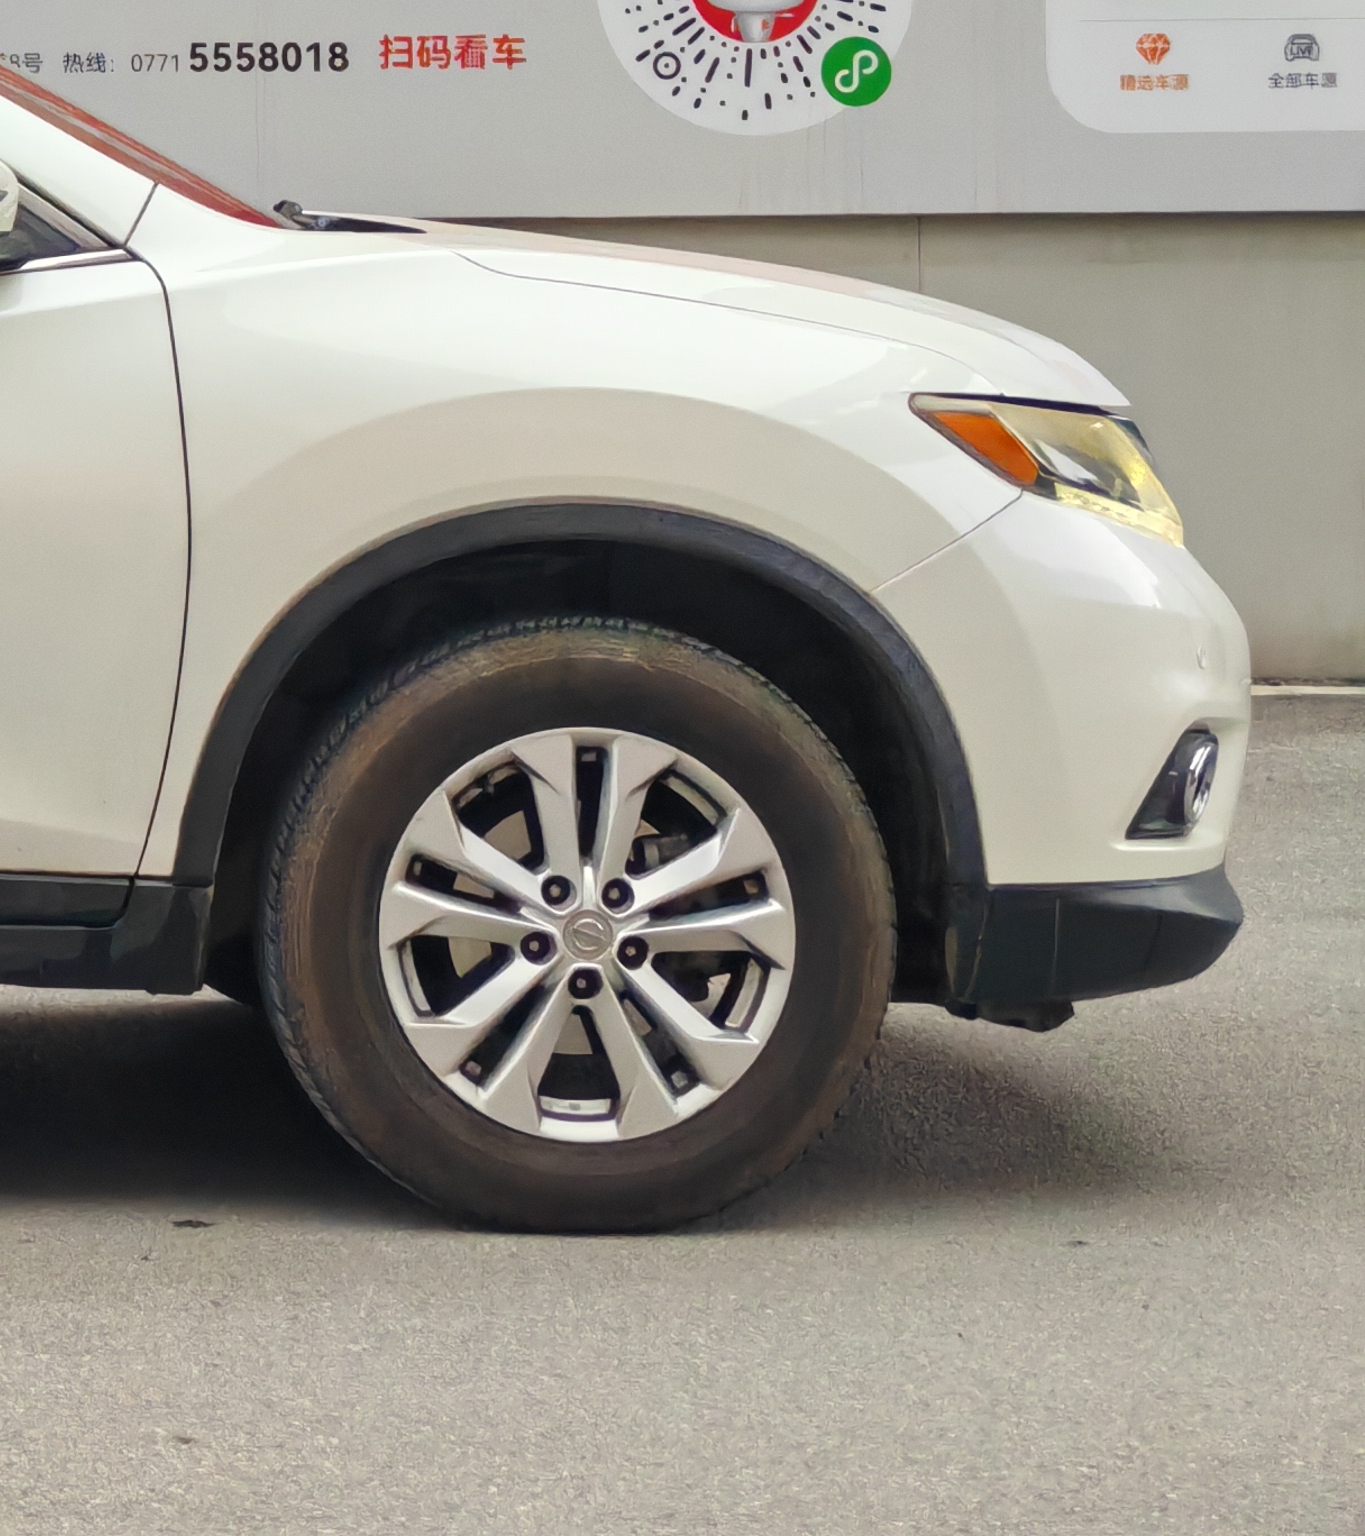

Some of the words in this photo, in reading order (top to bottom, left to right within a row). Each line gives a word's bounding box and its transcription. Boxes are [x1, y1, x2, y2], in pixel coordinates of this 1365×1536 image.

[131, 54, 180, 73] 0771
[189, 41, 350, 74] 5558018
[379, 34, 527, 71] 扫码看车
